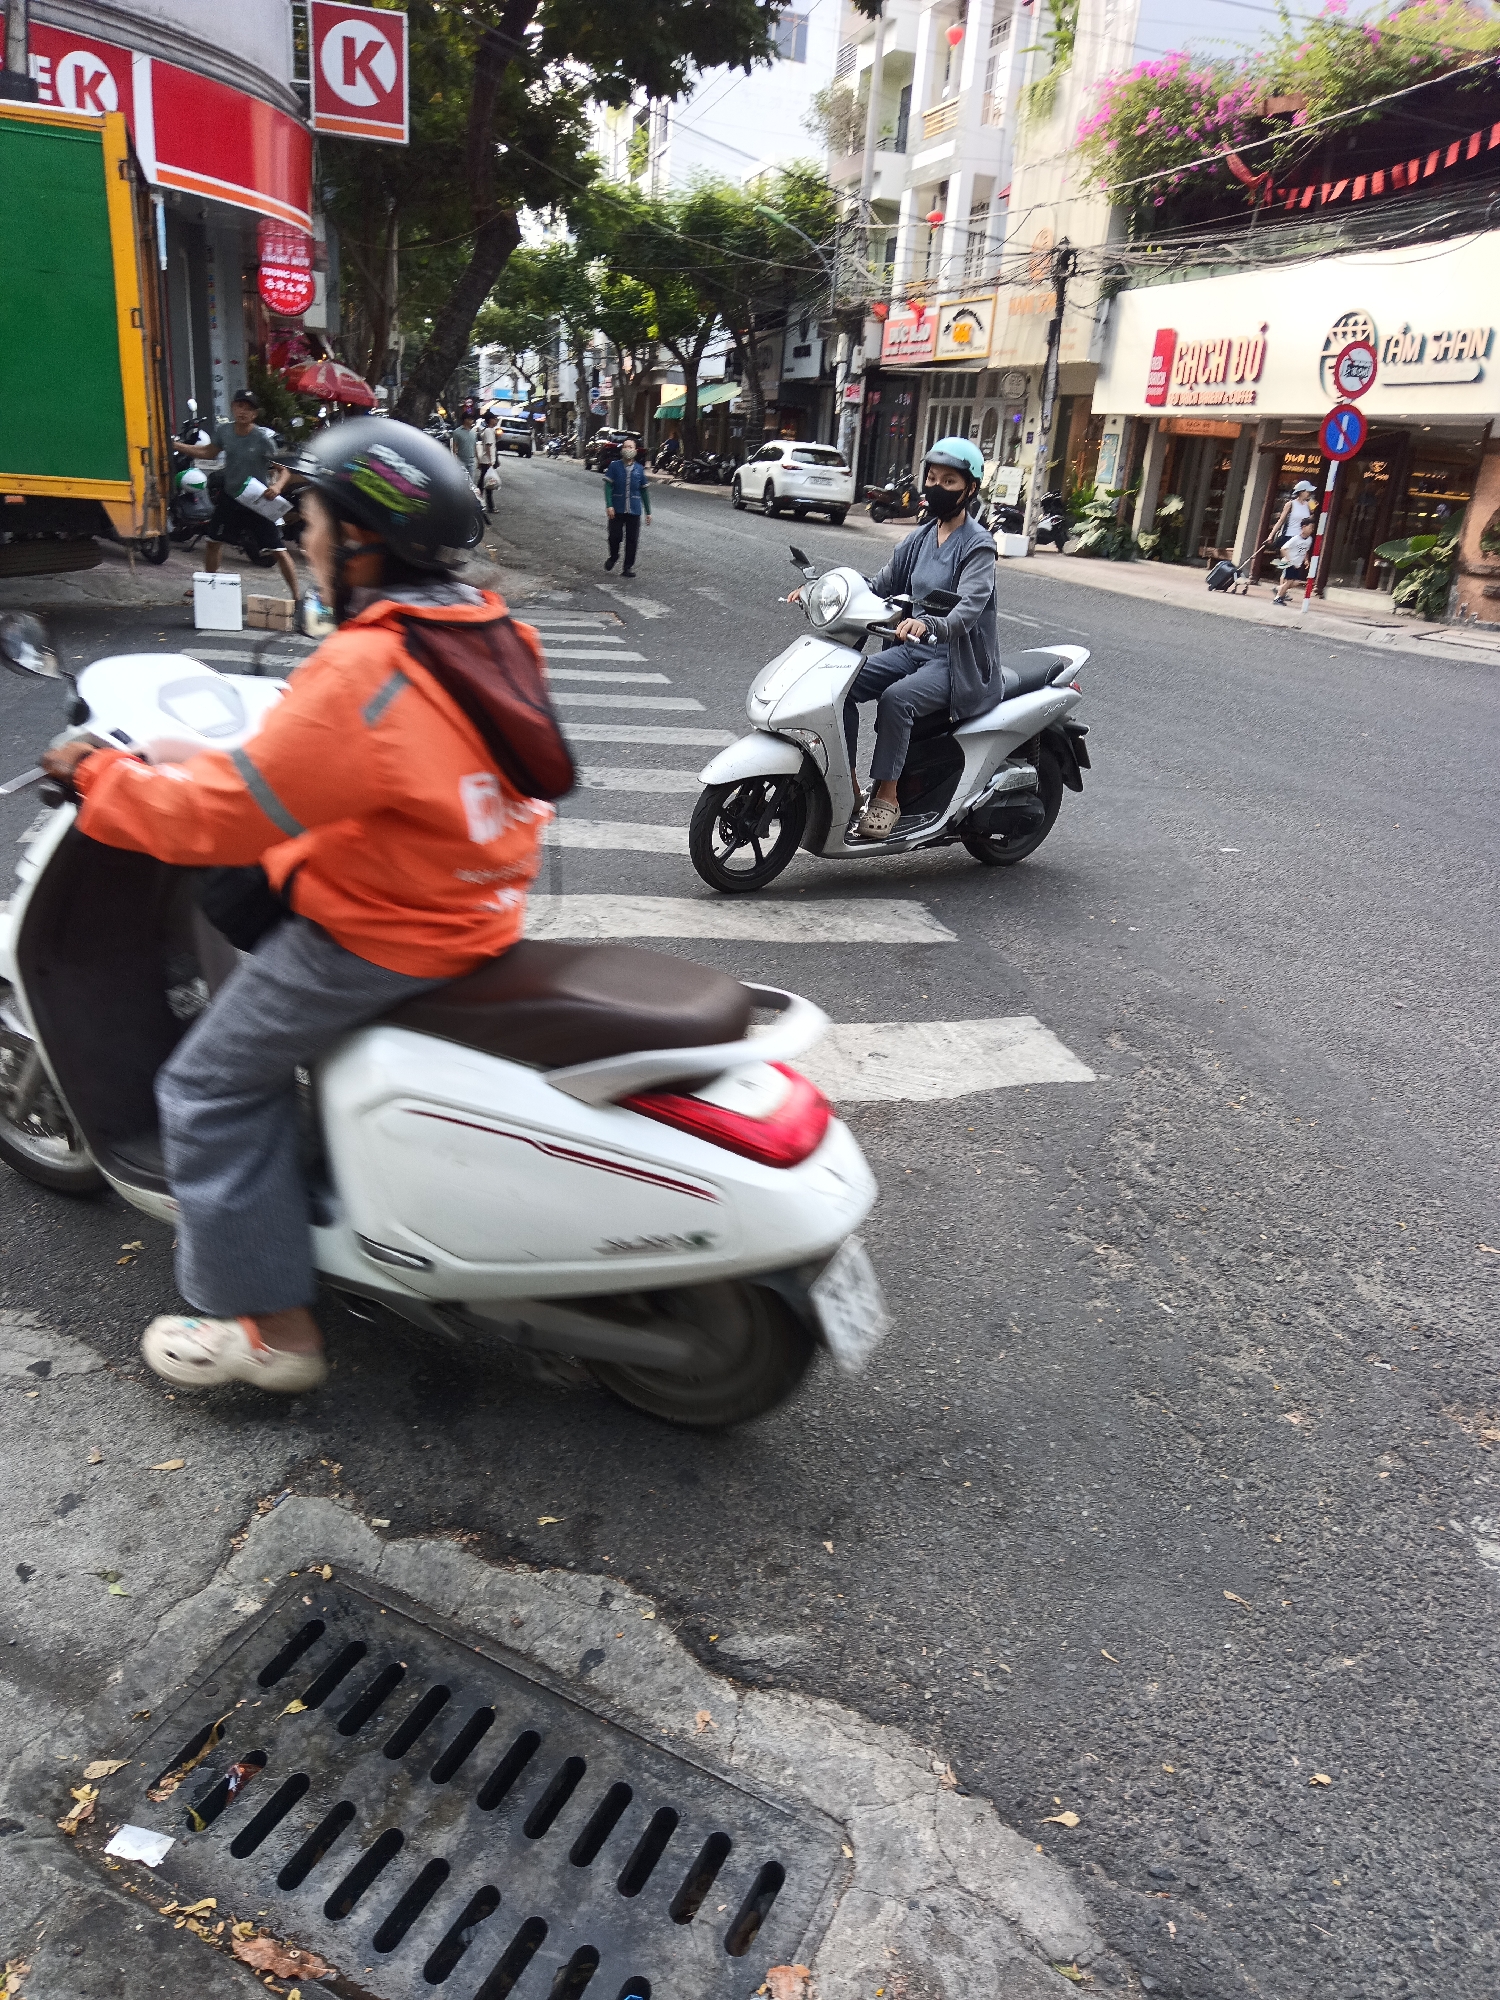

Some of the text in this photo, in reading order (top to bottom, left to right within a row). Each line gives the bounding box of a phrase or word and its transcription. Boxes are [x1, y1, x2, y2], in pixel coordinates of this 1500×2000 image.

[73, 64, 110, 112] K
[342, 35, 392, 104] K
[1172, 339, 1232, 391] GẠCH
[1431, 327, 1496, 362] SHAN
